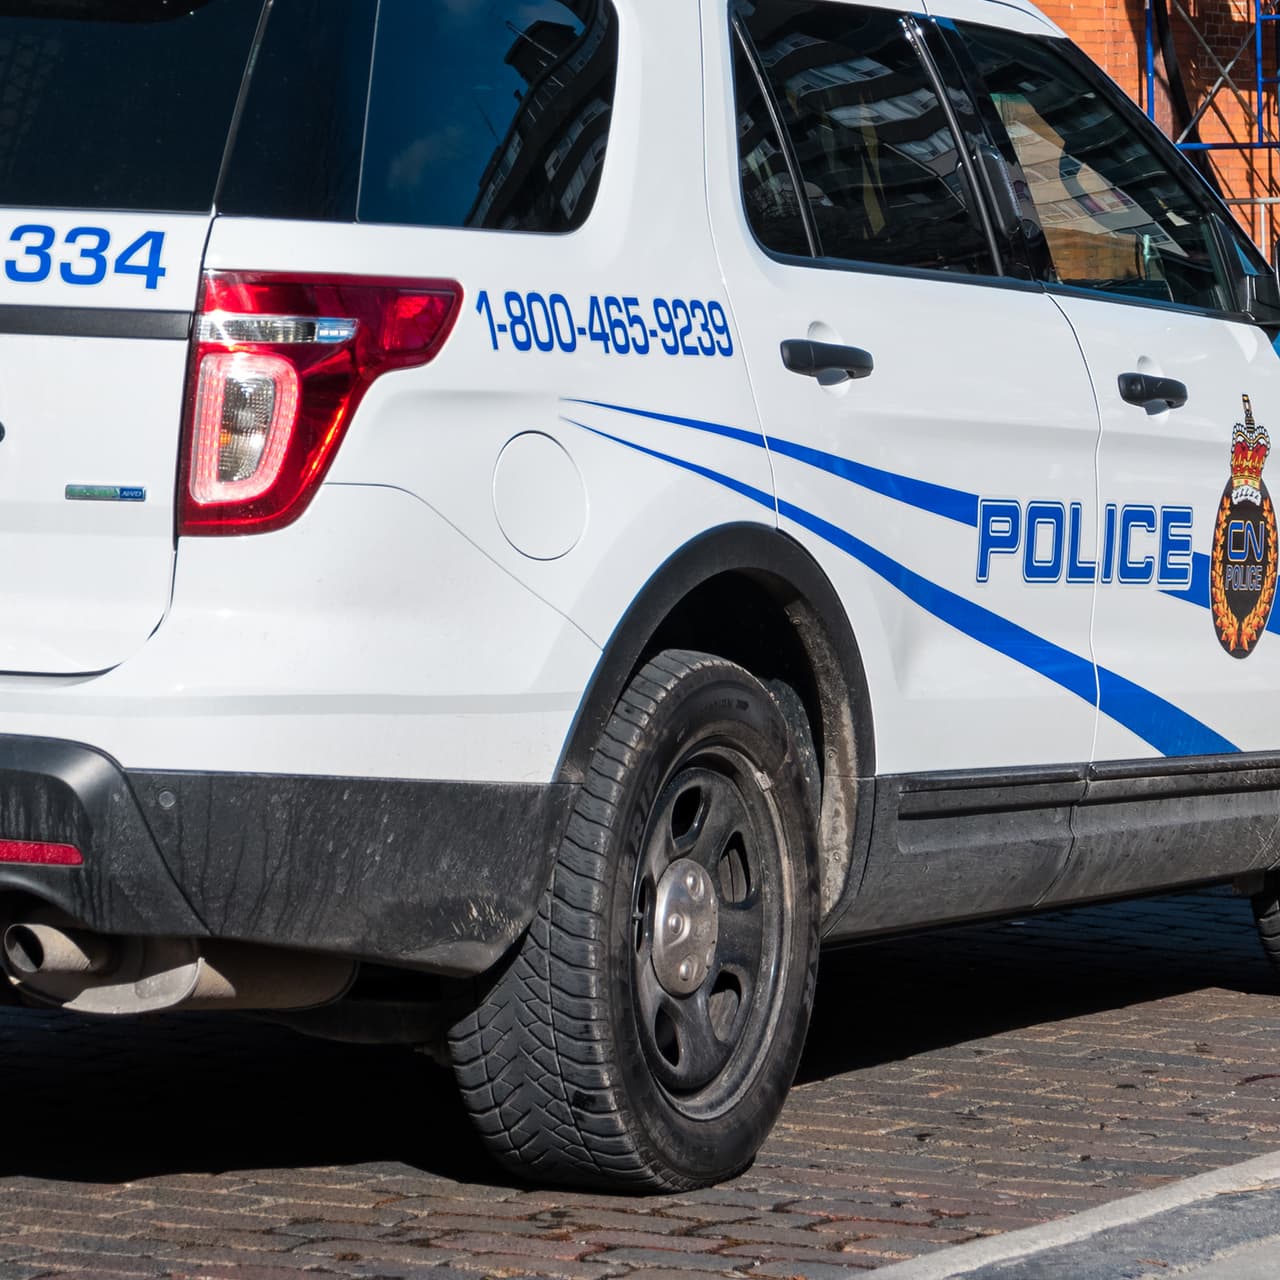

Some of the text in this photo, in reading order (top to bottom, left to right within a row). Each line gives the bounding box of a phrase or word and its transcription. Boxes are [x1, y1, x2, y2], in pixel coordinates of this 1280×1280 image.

[4, 223, 167, 291] 334
[475, 289, 734, 358] 1-800-465-9239
[976, 499, 1194, 584] POLICE
[1227, 519, 1265, 562] CN
[1224, 563, 1263, 592] POLICE
